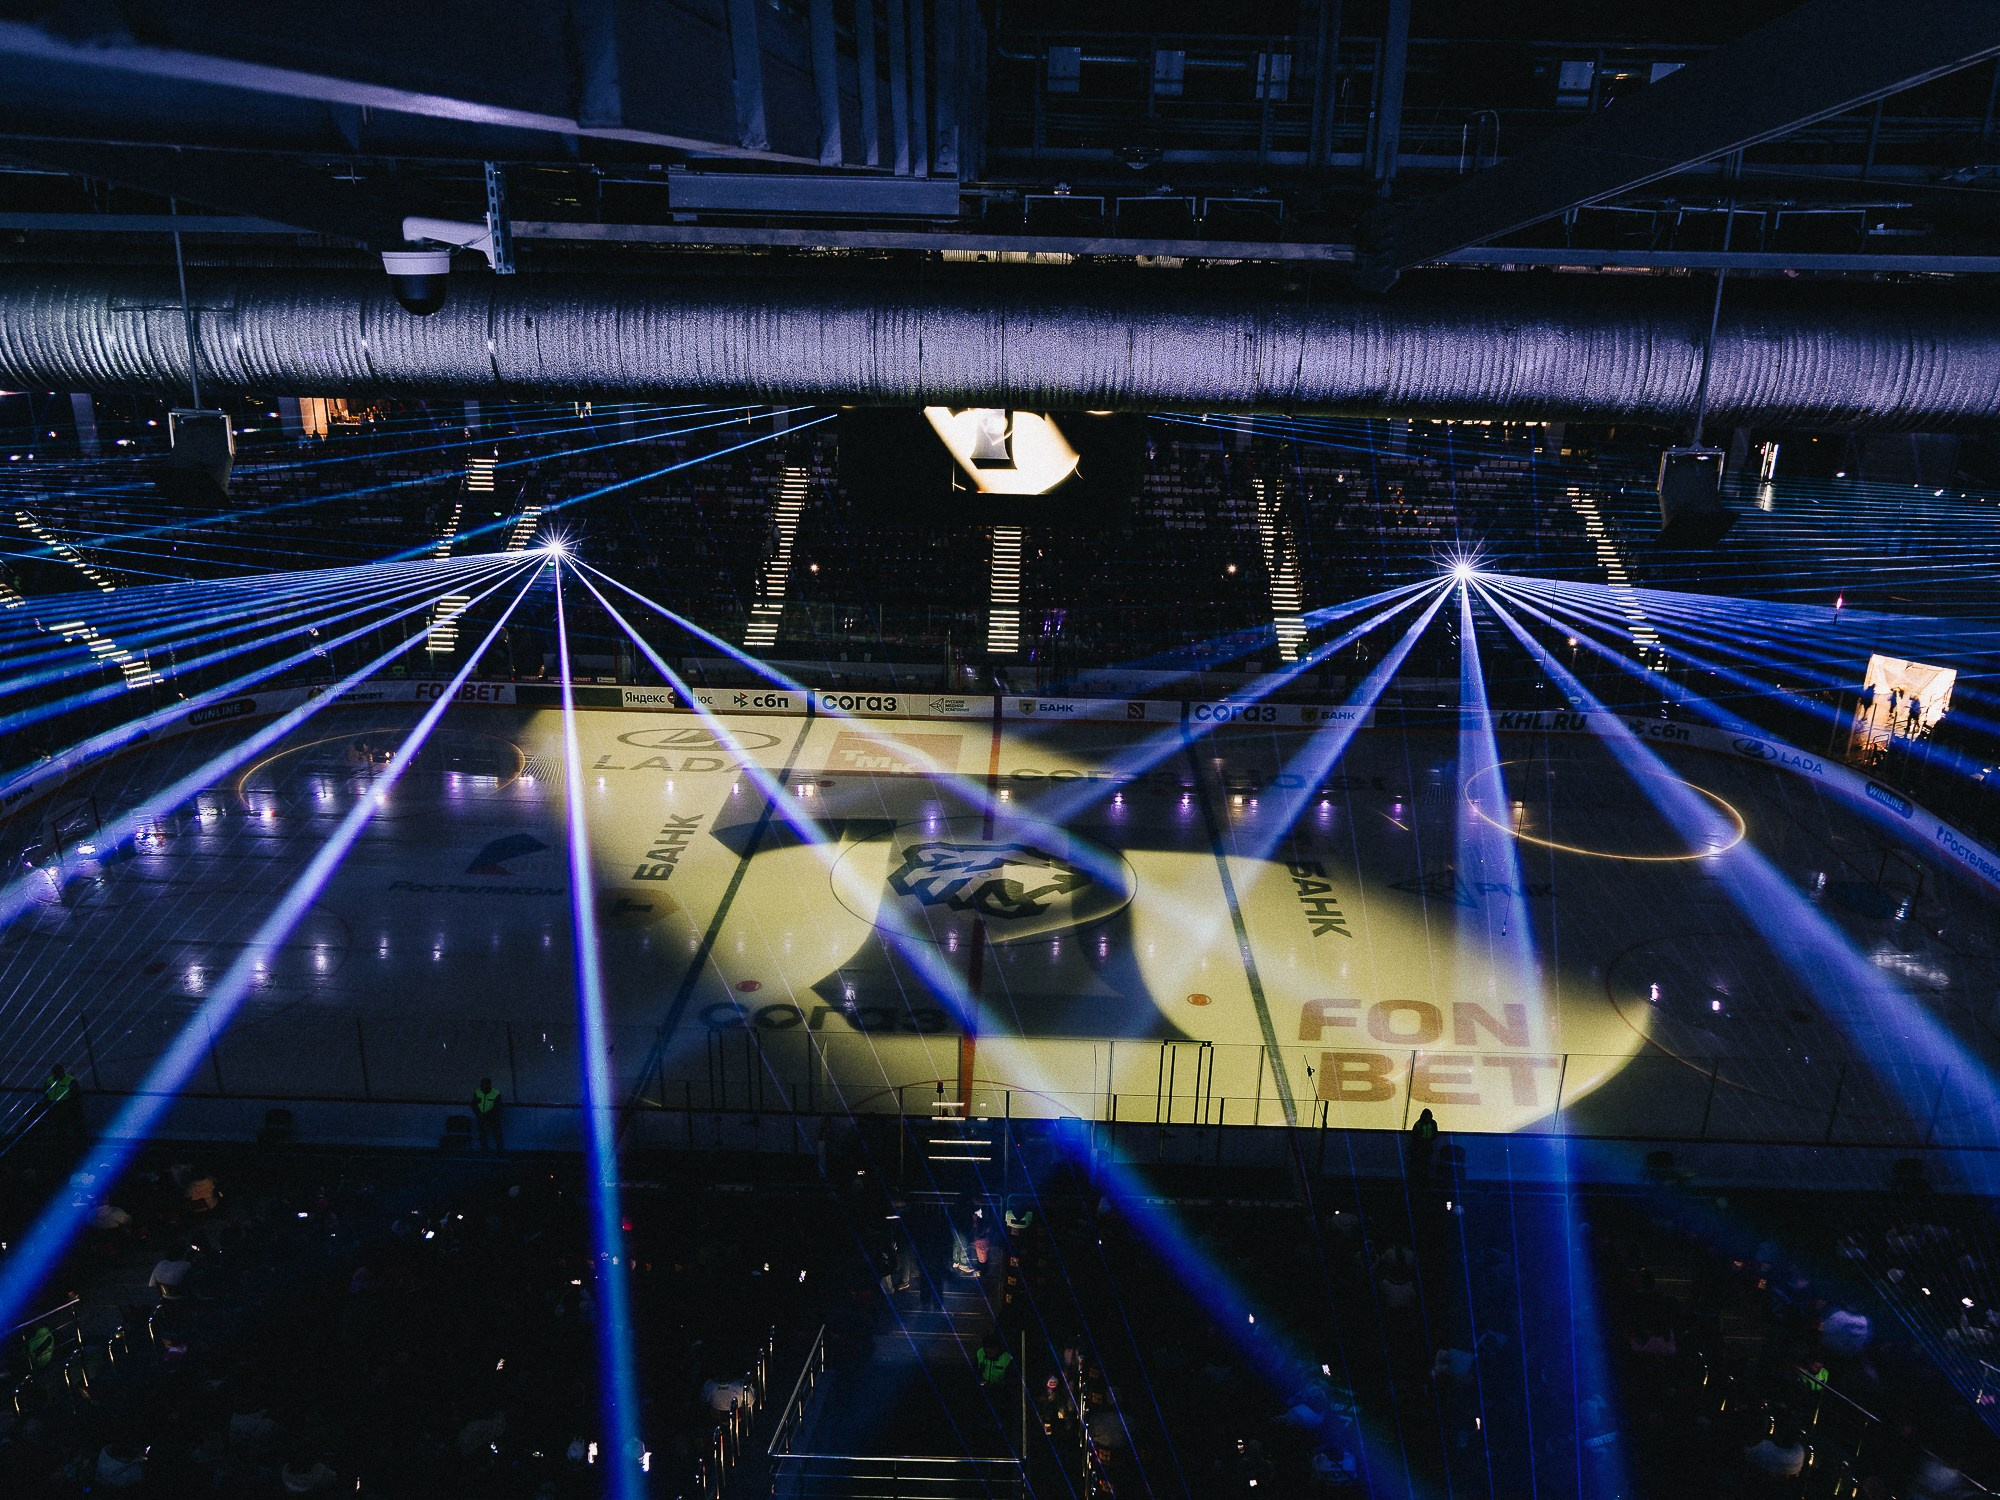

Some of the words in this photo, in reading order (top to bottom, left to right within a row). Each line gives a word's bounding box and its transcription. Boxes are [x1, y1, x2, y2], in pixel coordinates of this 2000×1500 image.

[625, 692, 665, 704] Яндекс
[1039, 704, 1074, 712] БАНК
[193, 704, 241, 721] WINLINE
[1321, 711, 1355, 720] БАНК
[1499, 712, 1587, 730] KHL.RU
[1780, 751, 1823, 775] LADA
[1869, 785, 1905, 811] WINLINE
[632, 813, 704, 881] БАНК
[1284, 861, 1353, 938] БАНК
[1298, 998, 1531, 1047] FON
[1317, 1051, 1558, 1107] BET
